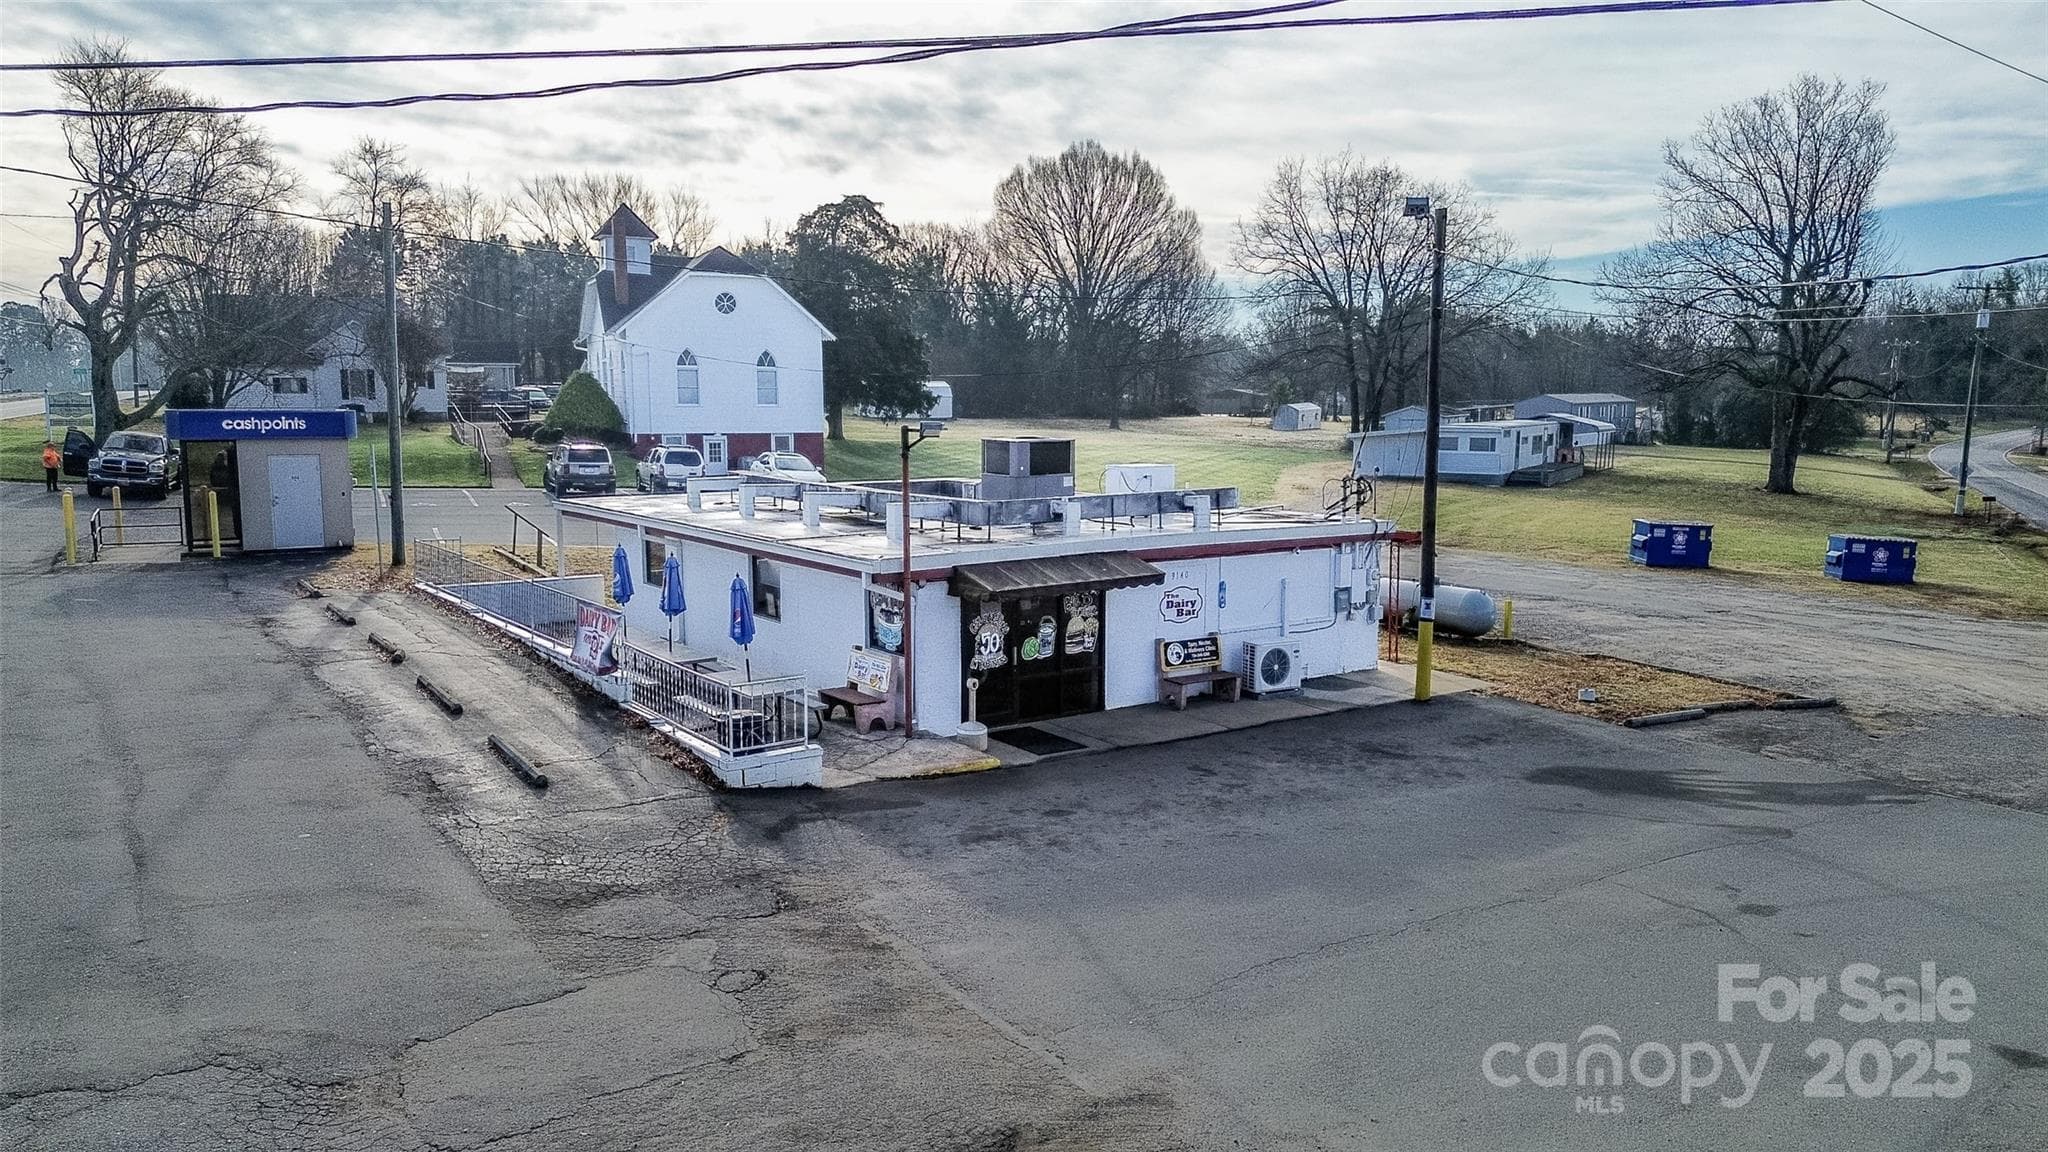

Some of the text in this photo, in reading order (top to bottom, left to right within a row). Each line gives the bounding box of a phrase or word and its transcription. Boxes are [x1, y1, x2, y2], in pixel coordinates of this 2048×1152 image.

[222, 416, 306, 434] cashpoints
[1166, 599, 1197, 609] Dairy
[1176, 609, 1197, 617] Bar
[980, 631, 1000, 656] 50
